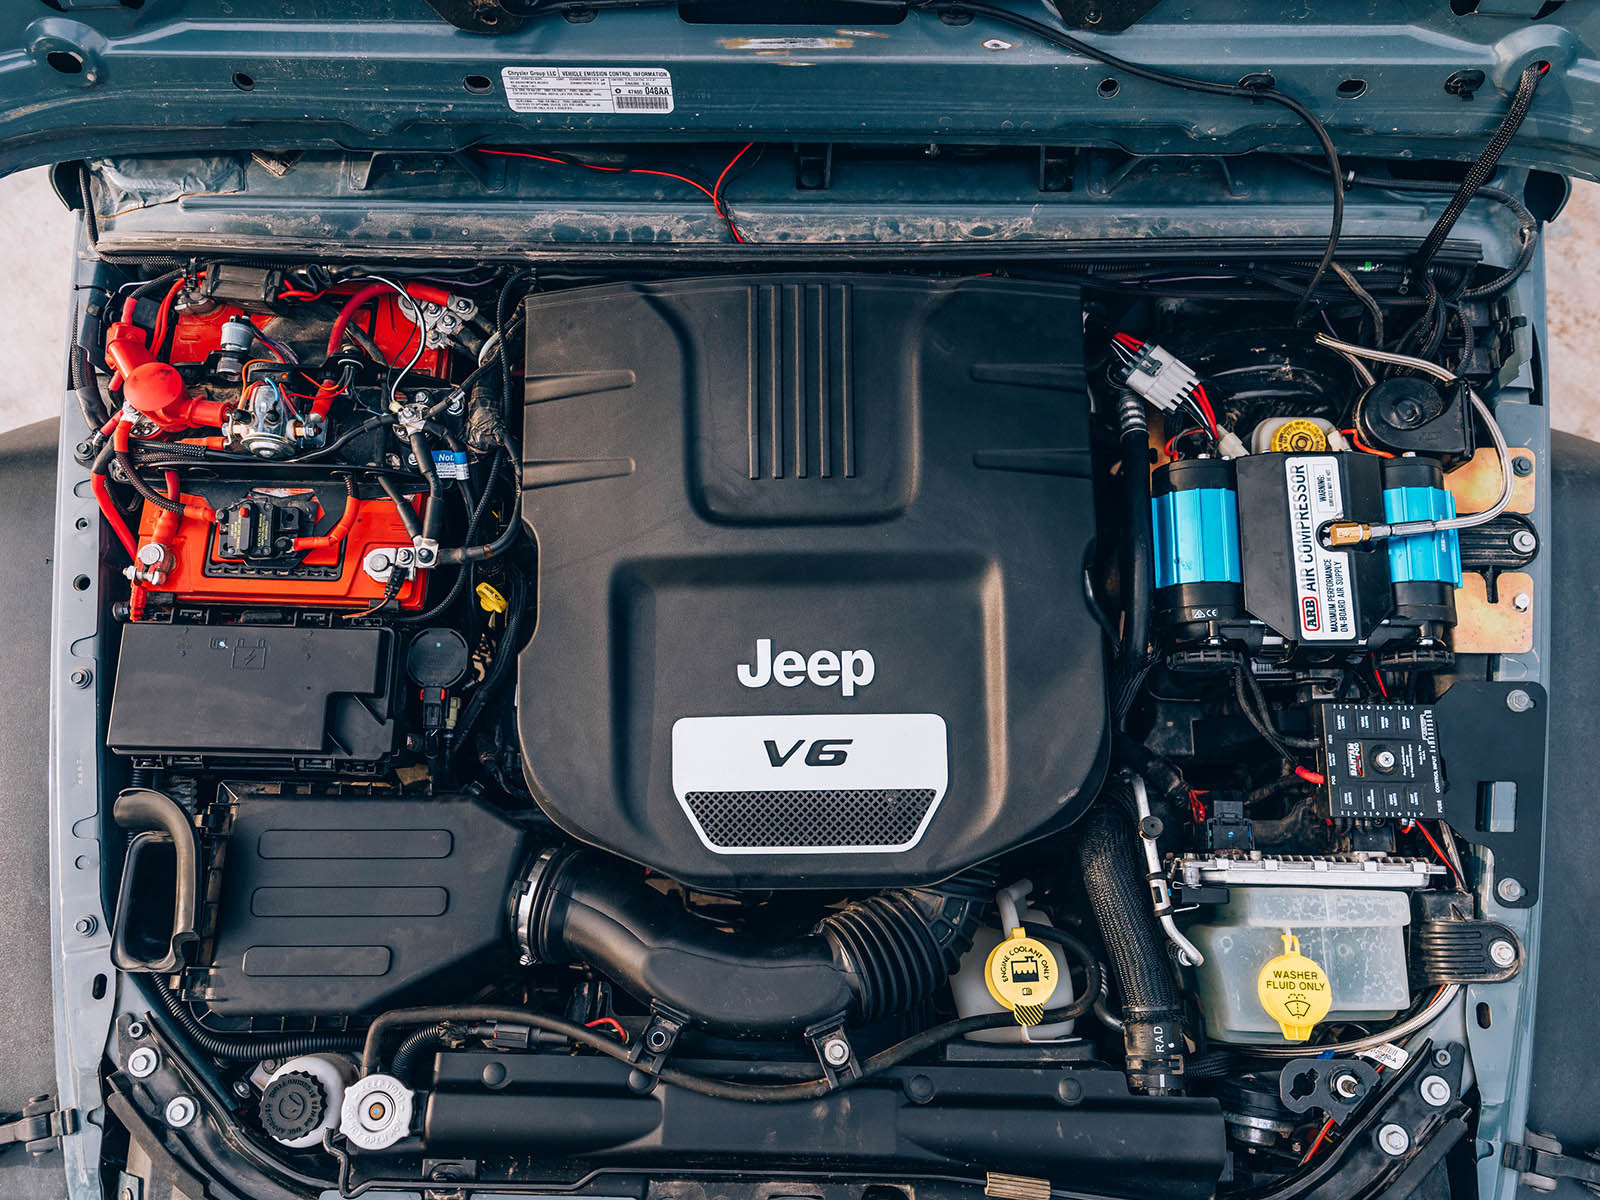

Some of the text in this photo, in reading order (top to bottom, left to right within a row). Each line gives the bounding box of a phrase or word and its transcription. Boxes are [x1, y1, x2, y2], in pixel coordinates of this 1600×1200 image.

[1317, 474, 1327, 503] WARNING:
[1290, 464, 1317, 592] AIR COMPRESSOR
[1323, 559, 1339, 633] MAXIMUM PERFORMANCE
[1333, 561, 1349, 633] ON-BOARD AIR SUPPLY
[1305, 599, 1318, 628] ARB
[736, 638, 875, 697] Jeep
[763, 738, 854, 768] V6
[1347, 743, 1358, 776] BANTAM
[1000, 945, 1051, 983] ENGINE COOLANT ONLY
[1273, 970, 1318, 980] WASHER
[1266, 980, 1325, 991] FLUID ONLY
[1153, 1026, 1165, 1053] RAD
